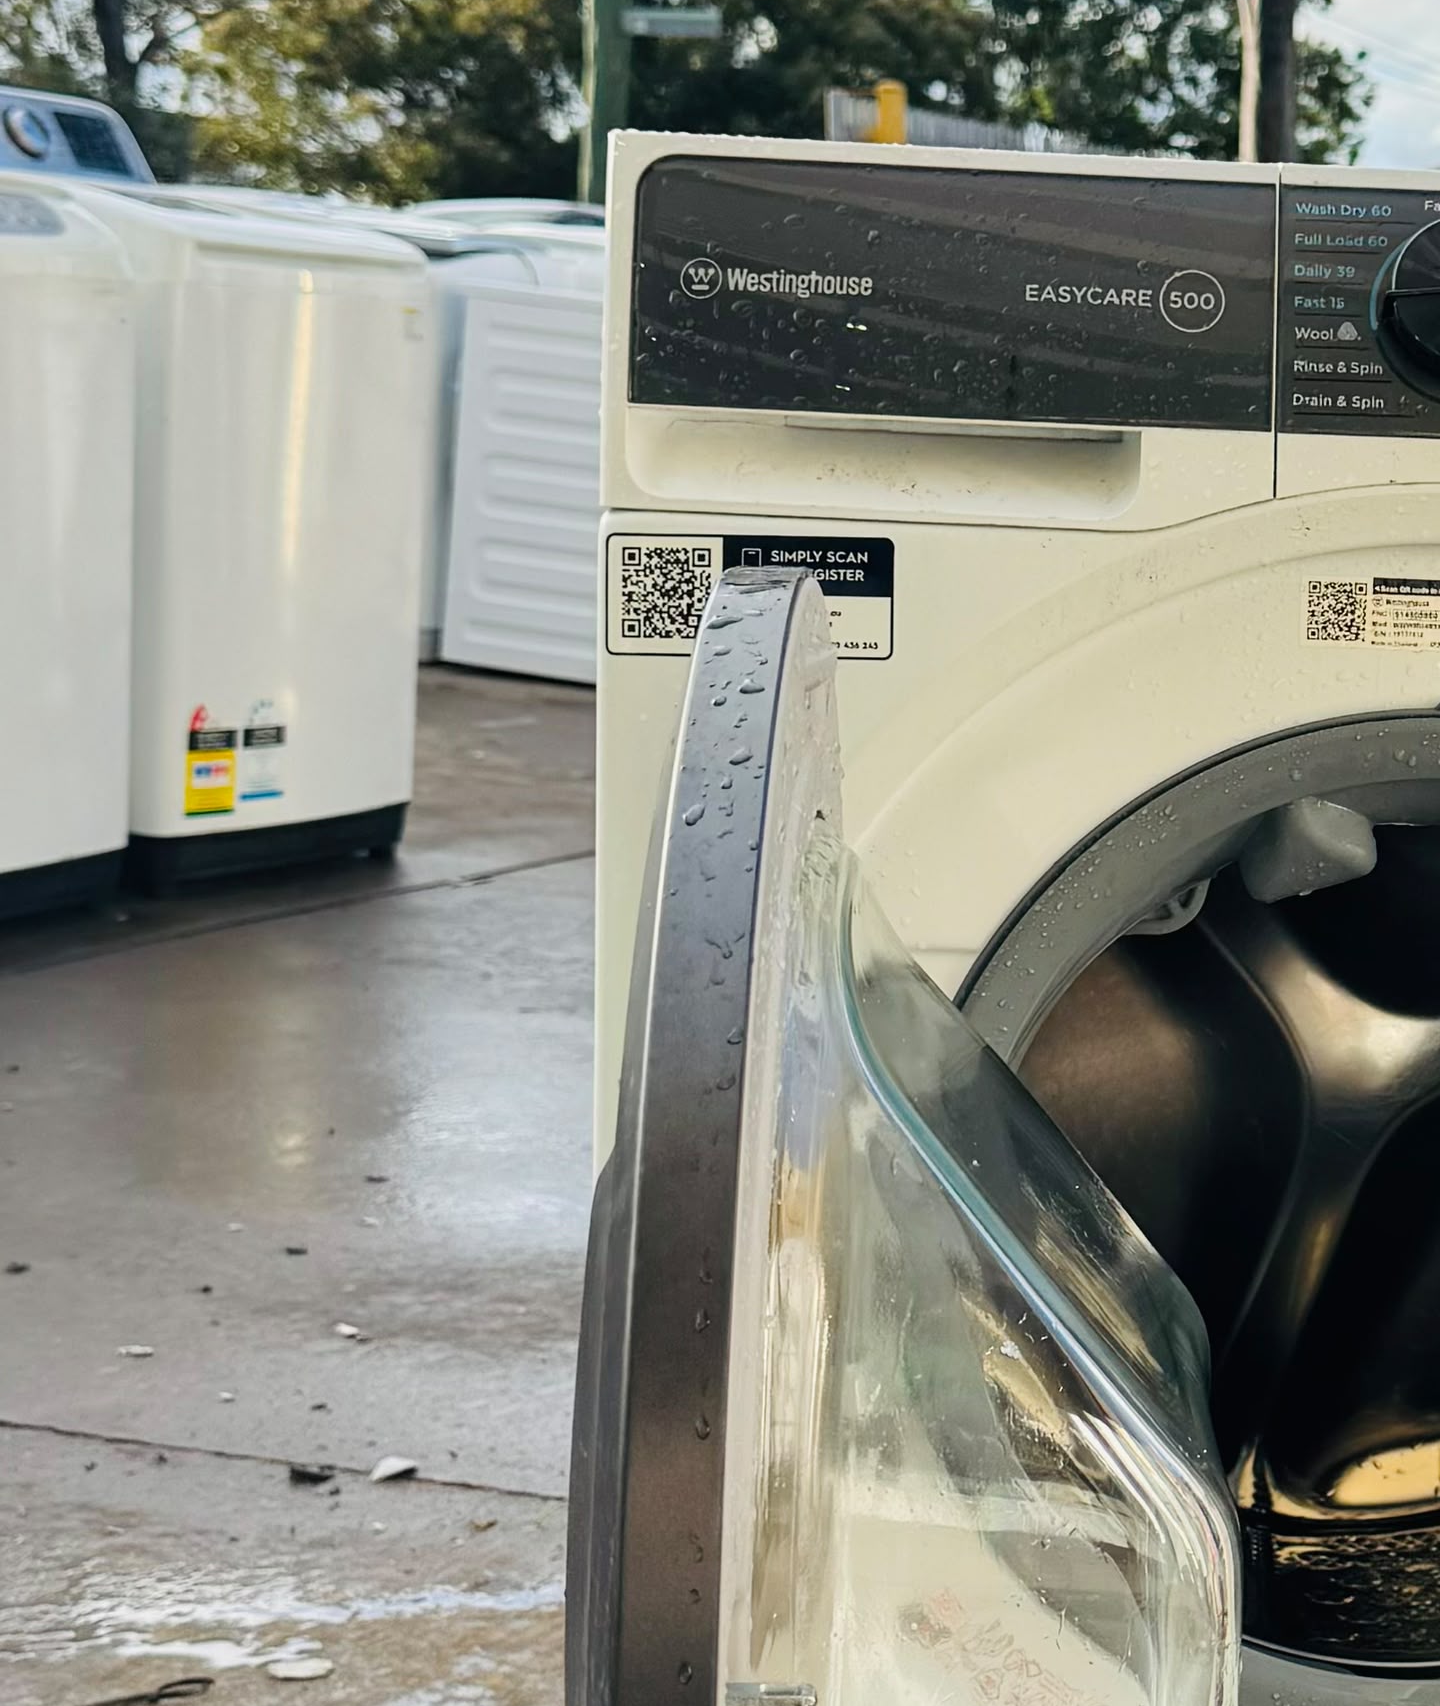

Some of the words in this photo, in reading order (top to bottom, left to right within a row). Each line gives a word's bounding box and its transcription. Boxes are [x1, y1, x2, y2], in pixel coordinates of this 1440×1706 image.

[1296, 202, 1335, 215] Wash
[1340, 204, 1366, 218] Dry
[1371, 204, 1392, 217] 60
[1294, 233, 1322, 246] Full
[1326, 234, 1363, 247] Load
[1368, 236, 1388, 247] 60
[1294, 264, 1332, 279] Daily
[727, 268, 873, 298] Westinghouse
[1025, 284, 1153, 308] EASYCARE
[1169, 292, 1216, 310] 500
[1294, 296, 1326, 309] Fast
[1294, 326, 1333, 340] Wool
[1293, 360, 1333, 373] Rinse
[1337, 362, 1347, 373] &
[1350, 362, 1383, 376] Spin
[1292, 393, 1332, 406] Drain
[1336, 395, 1347, 407] &
[1351, 395, 1384, 410] Spin
[770, 550, 822, 564] SIMPLY
[826, 551, 868, 564] SCAN
[813, 568, 865, 583] GISTER
